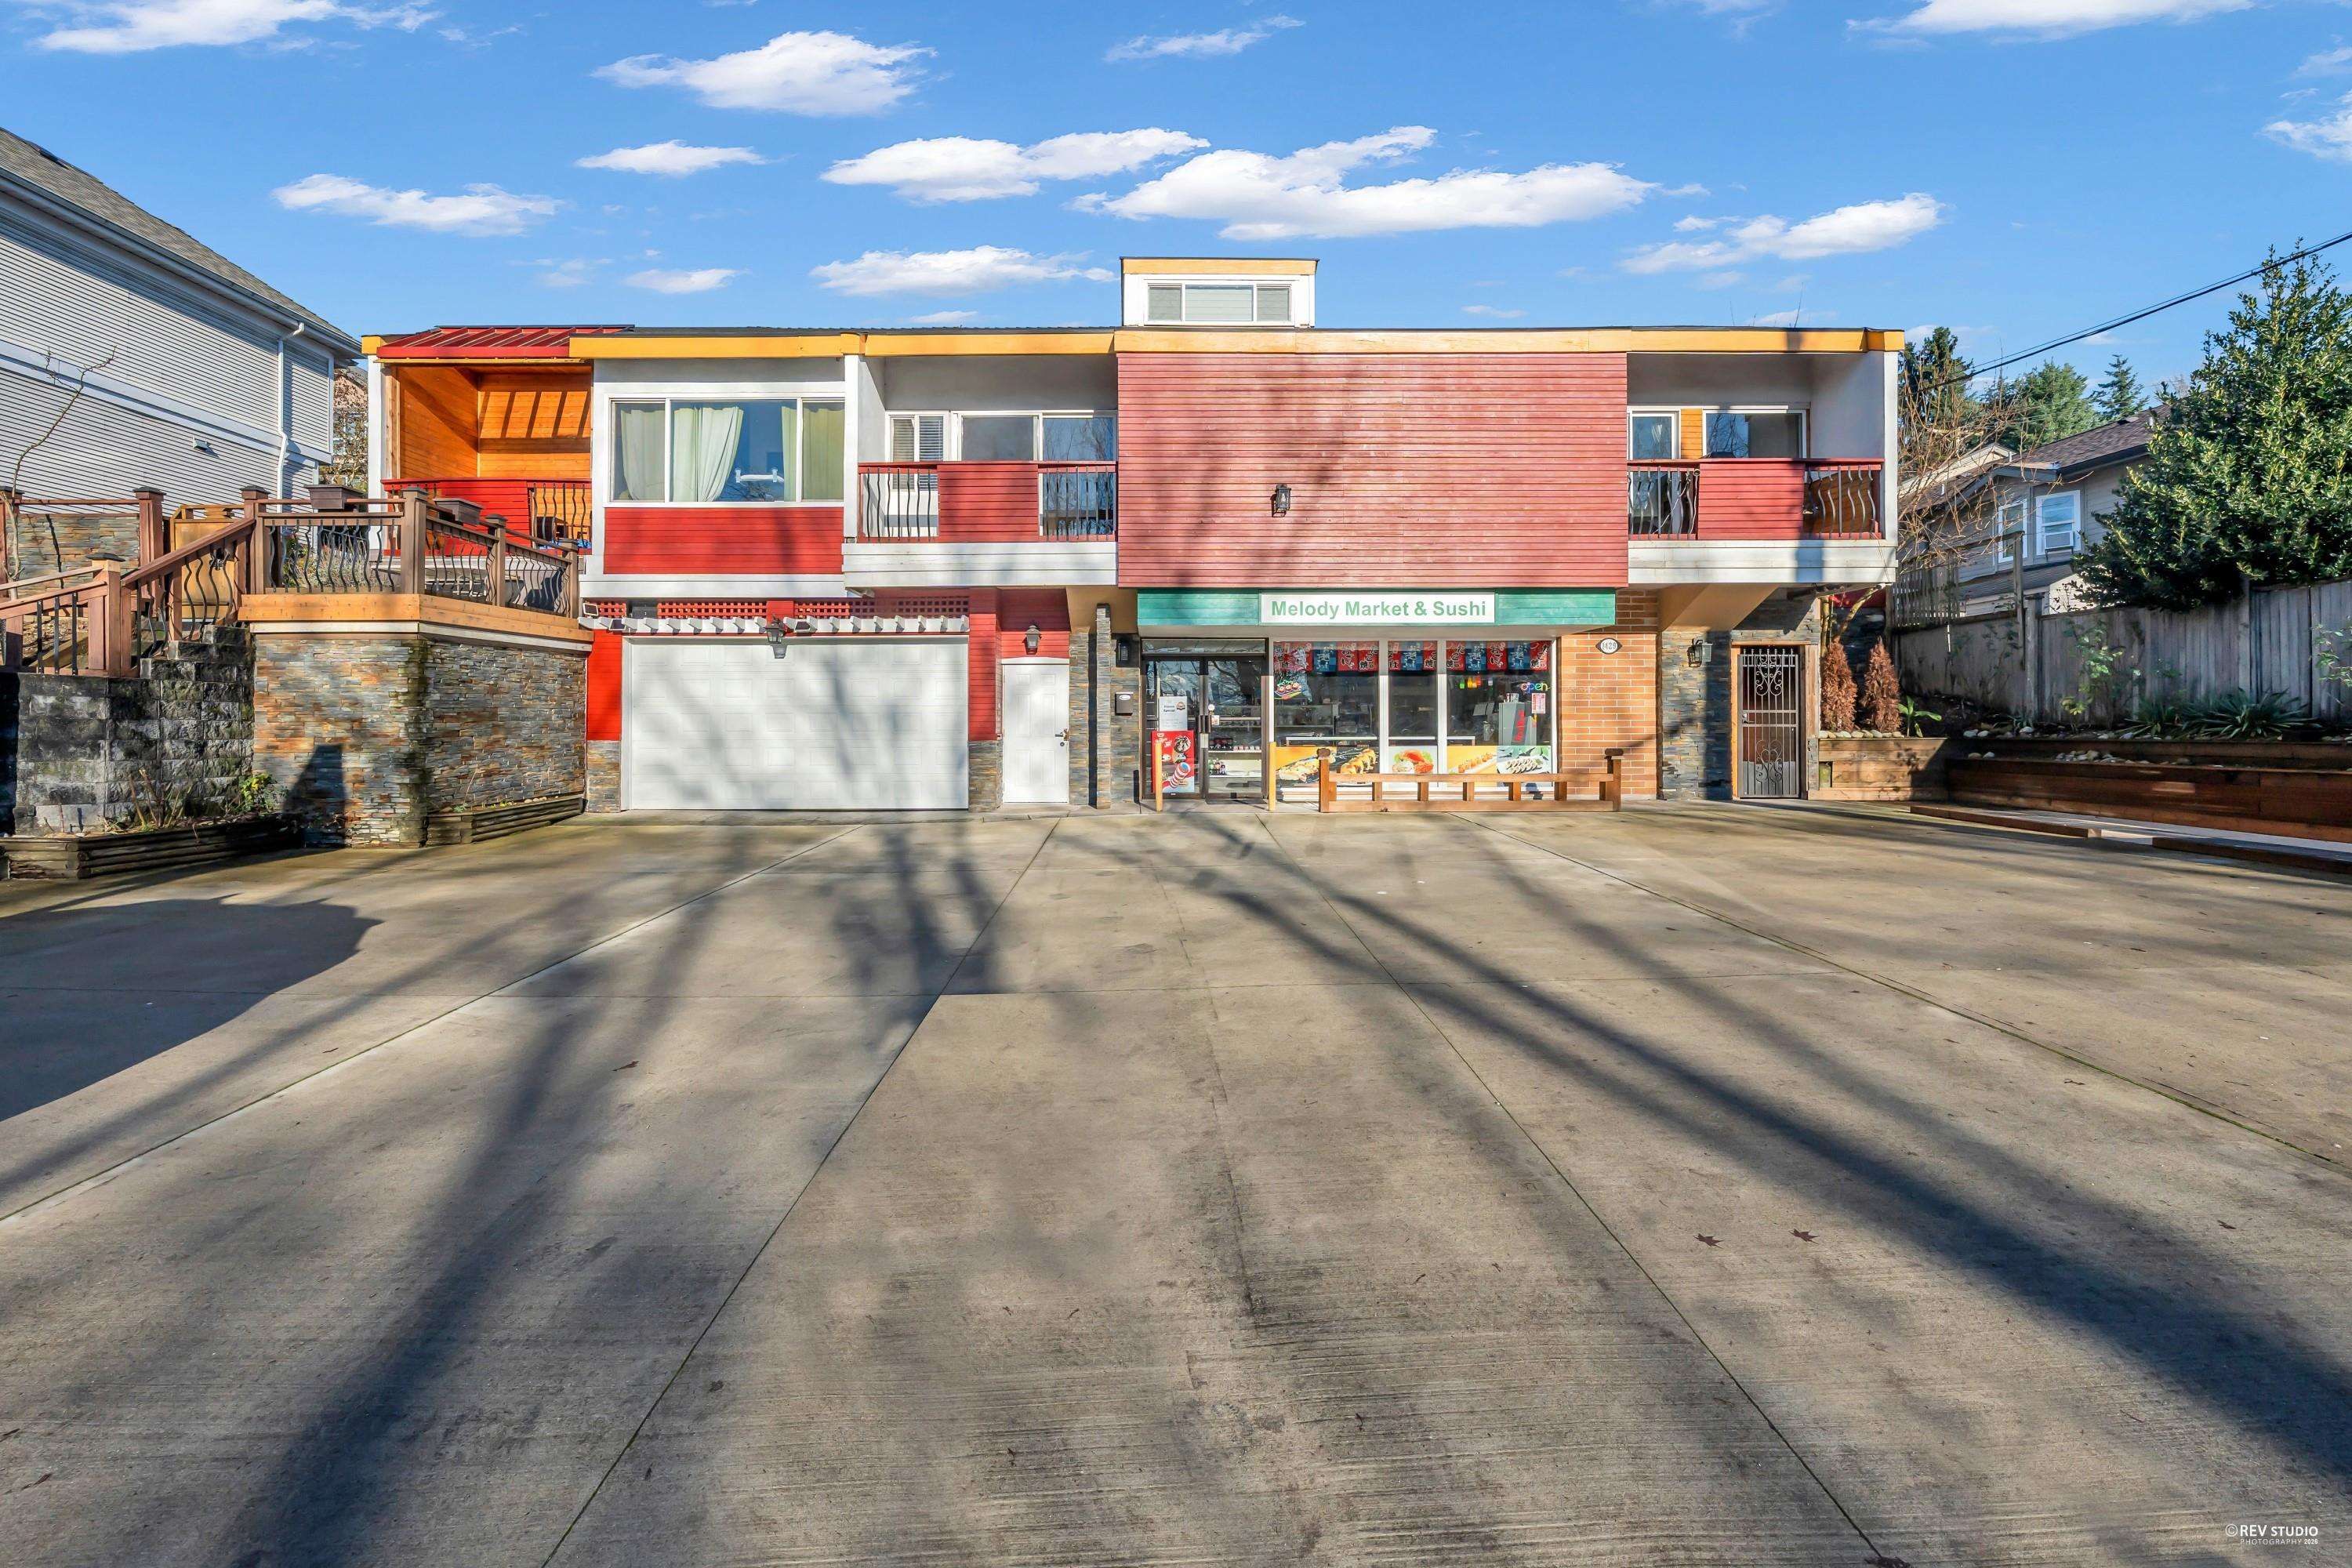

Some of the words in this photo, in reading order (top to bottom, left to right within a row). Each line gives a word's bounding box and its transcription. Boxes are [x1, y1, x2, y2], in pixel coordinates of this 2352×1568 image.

[1271, 601, 1339, 619] Melody
[1345, 601, 1409, 616] Market
[1414, 601, 1428, 616] &
[1432, 601, 1486, 616] Sushi
[1521, 682, 1548, 694] open
